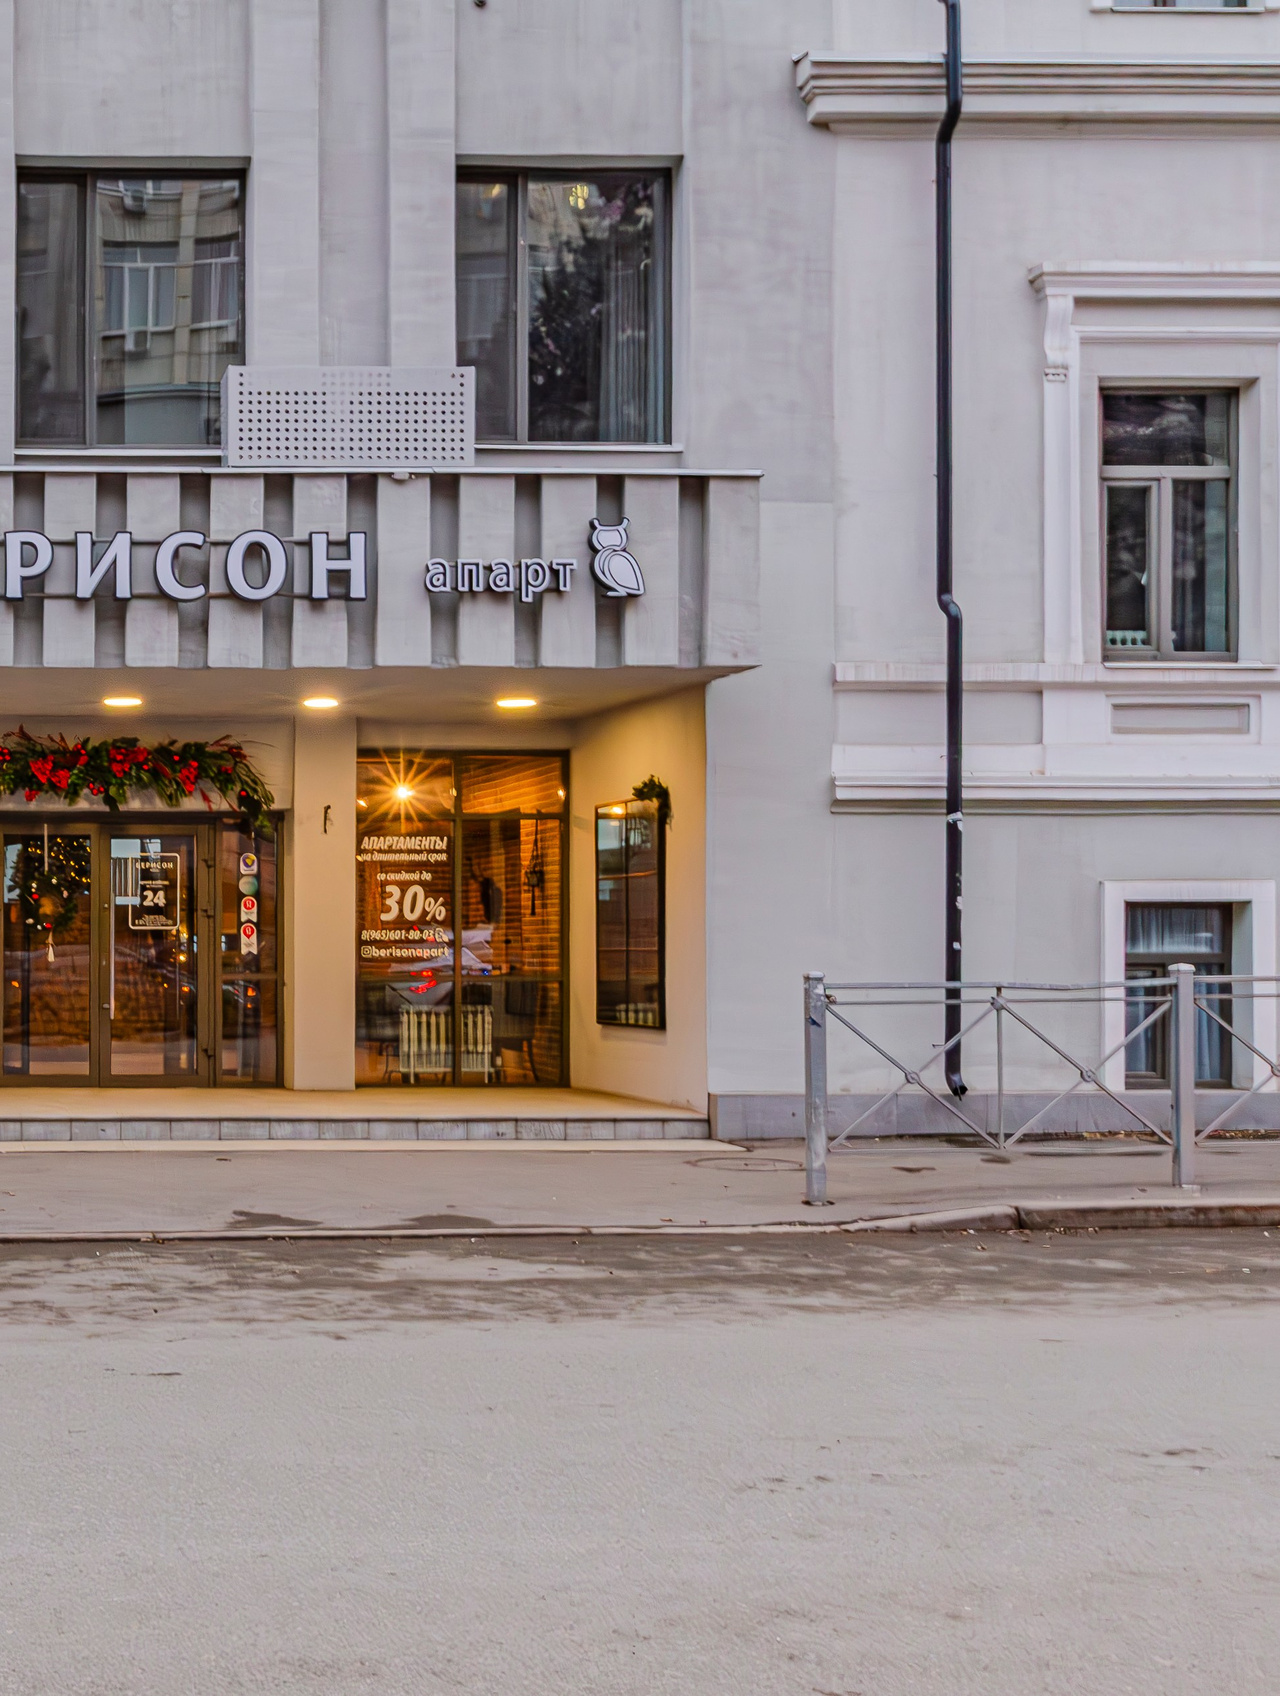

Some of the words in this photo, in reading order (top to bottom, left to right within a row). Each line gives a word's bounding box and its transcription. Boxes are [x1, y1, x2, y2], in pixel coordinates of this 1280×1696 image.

[425, 558, 578, 602] апарт
[361, 836, 448, 850] АПАРТАМЕНТЫ
[377, 872, 386, 881] со
[386, 871, 420, 881] скидкой
[421, 871, 432, 881] до
[143, 890, 166, 907] 24
[380, 884, 446, 921] 30%
